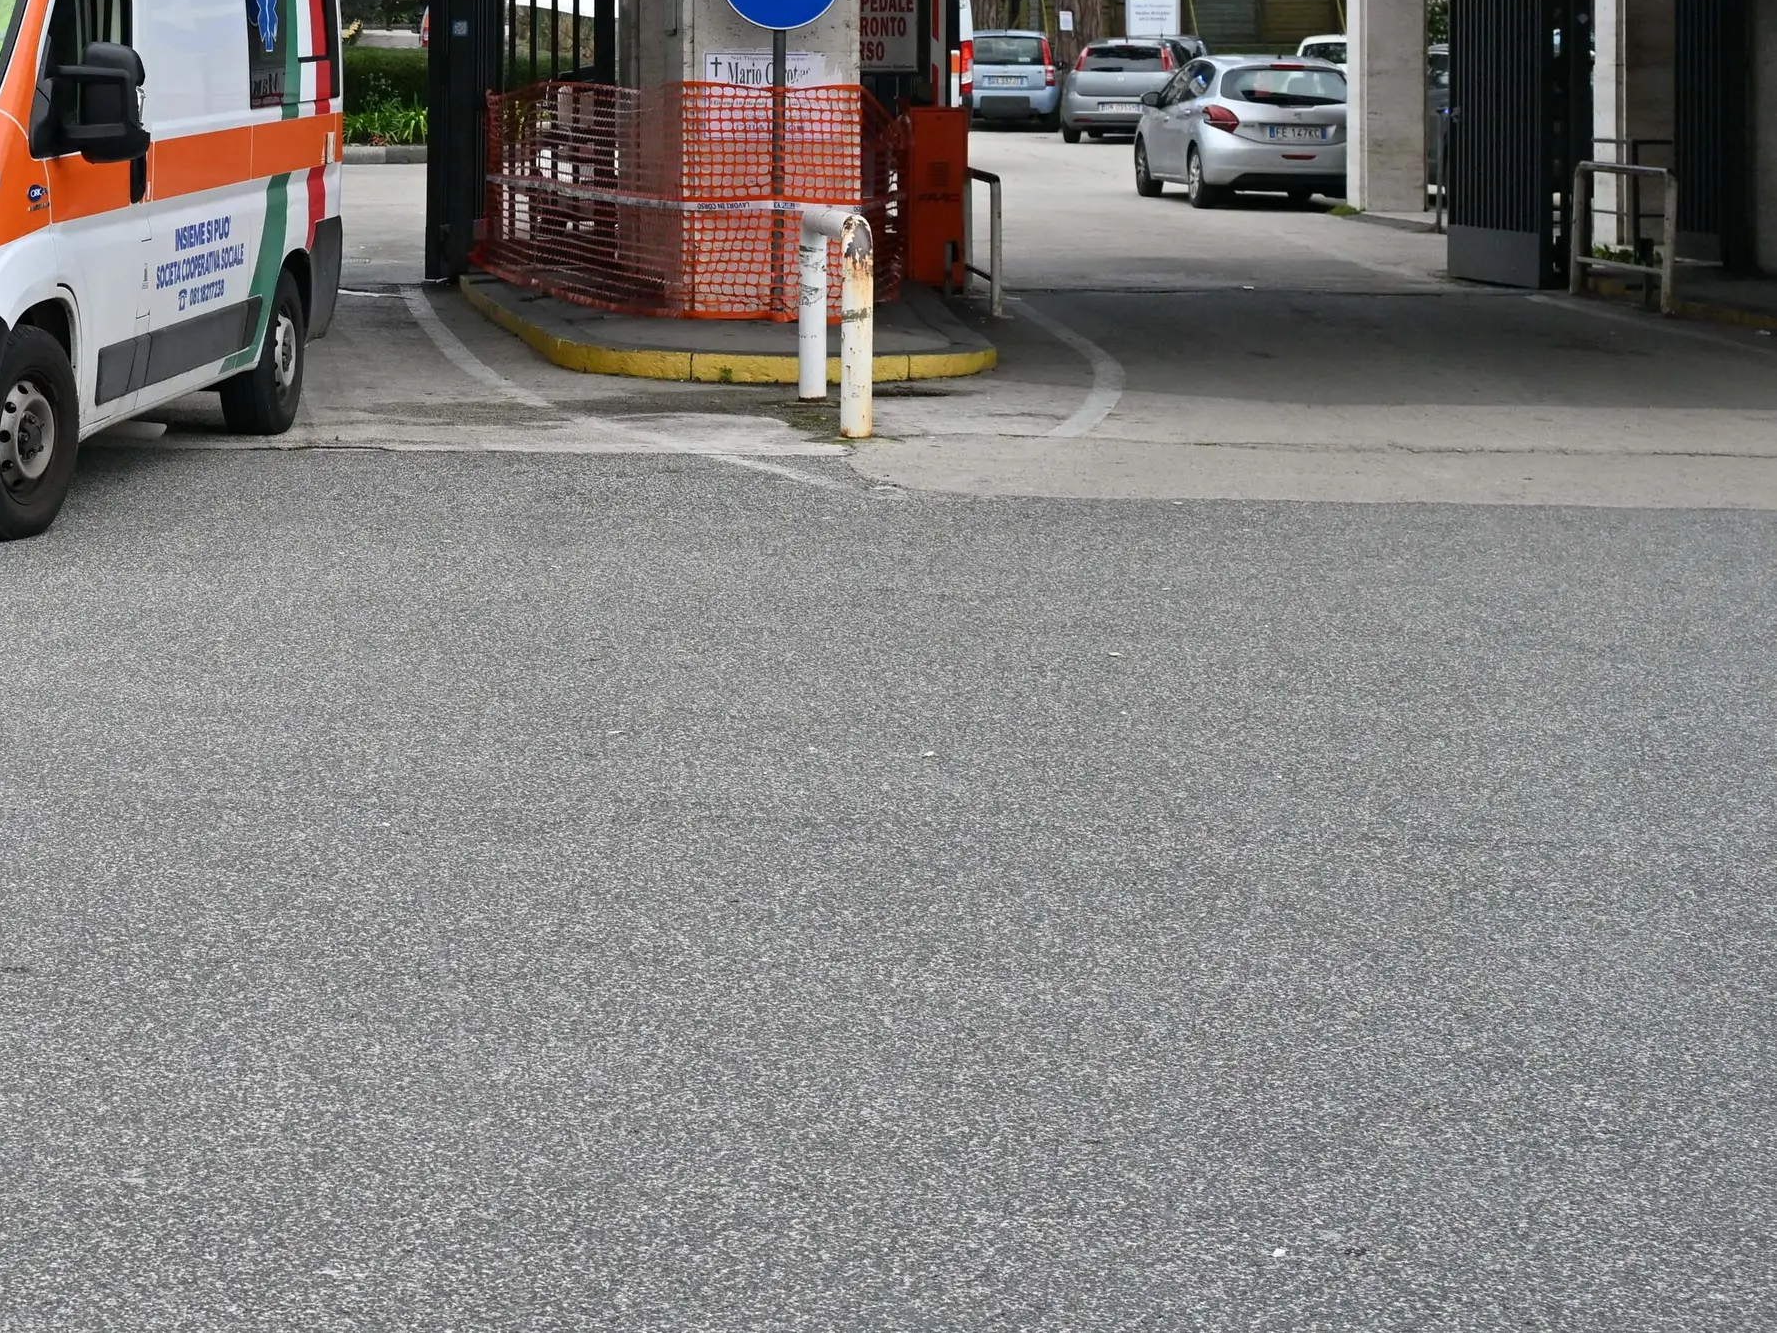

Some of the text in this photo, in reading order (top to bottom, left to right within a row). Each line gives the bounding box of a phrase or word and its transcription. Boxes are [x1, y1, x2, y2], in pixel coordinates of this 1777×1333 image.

[860, 16, 907, 37] RONTO
[727, 61, 762, 85] Mario
[175, 222, 206, 252] INSIEME
[206, 220, 214, 243] SI
[182, 249, 221, 282] COOPERATIVA
[220, 243, 244, 270] SOCIALE
